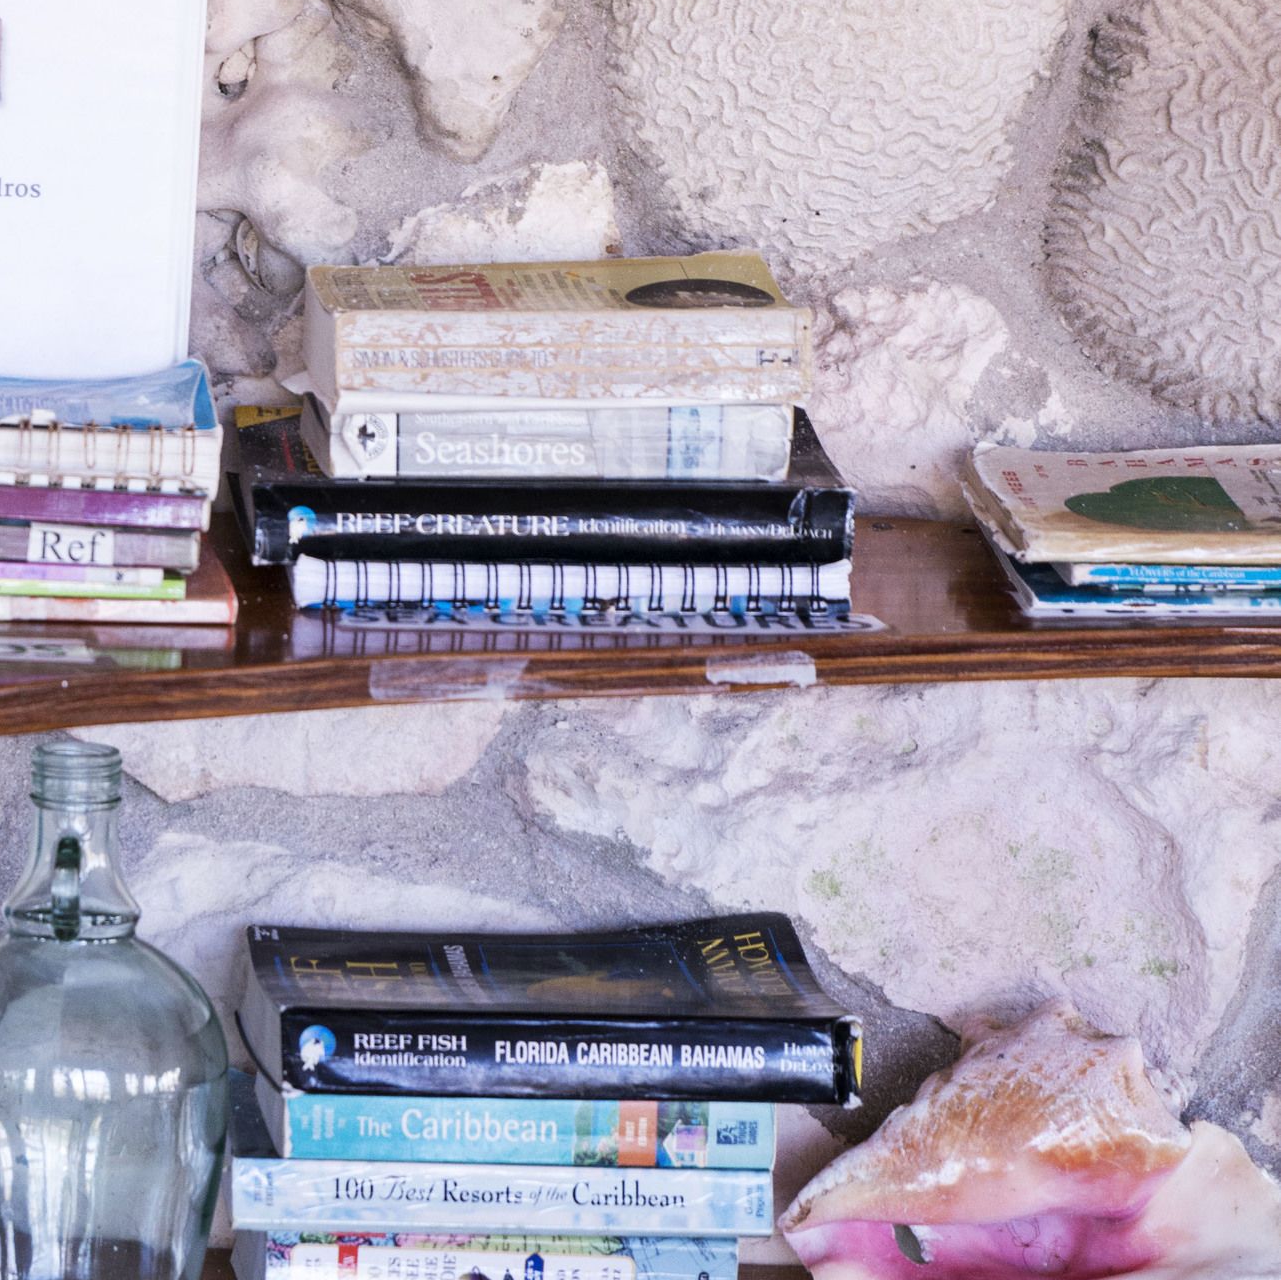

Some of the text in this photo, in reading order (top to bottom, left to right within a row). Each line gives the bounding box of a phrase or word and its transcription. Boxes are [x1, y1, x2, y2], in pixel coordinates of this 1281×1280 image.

[416, 432, 585, 466] Seashores
[337, 512, 687, 536] REEF CREATURE Identification
[41, 530, 105, 562] Ref
[353, 1033, 467, 1052] REEF FISH
[495, 1040, 765, 1069] FLORIDA CARIBBEAN BAHAMAS
[353, 1050, 467, 1068] Identification
[357, 1116, 391, 1137] The
[401, 1108, 559, 1143] Caribbean
[333, 1176, 685, 1208] 100 Best Resorts of the Caribbean
